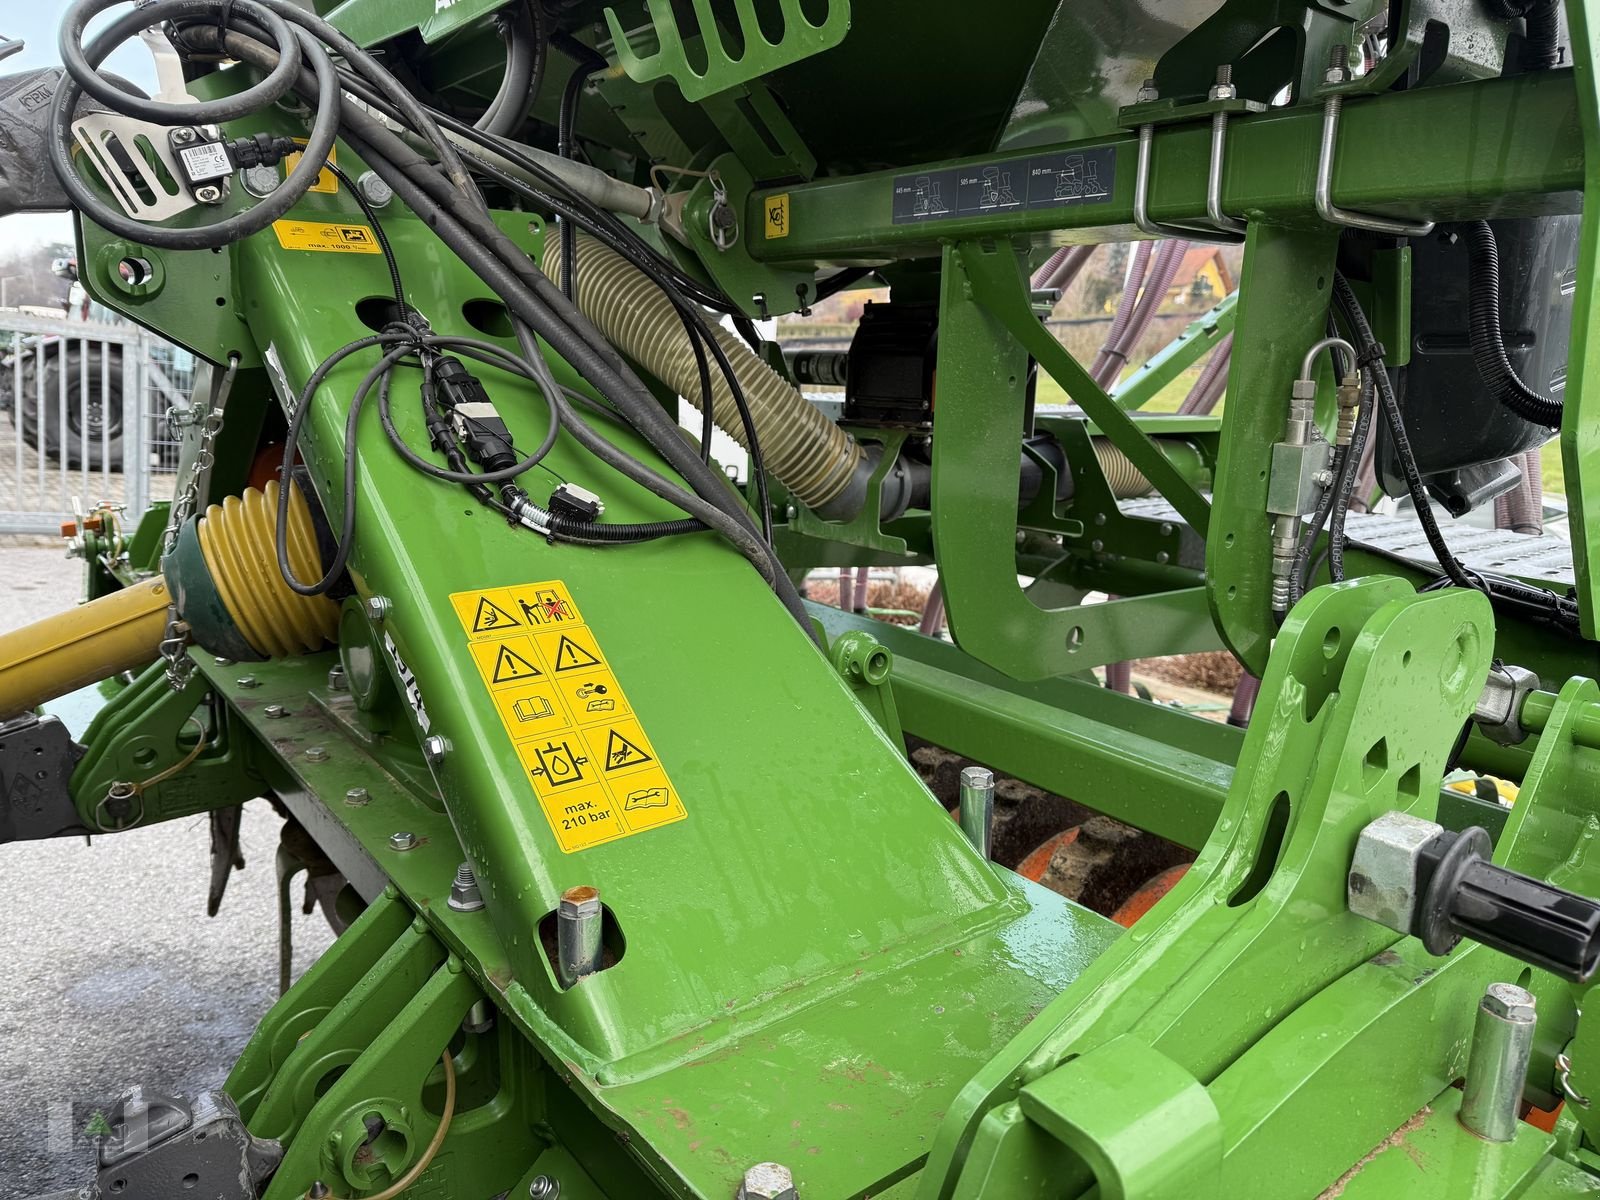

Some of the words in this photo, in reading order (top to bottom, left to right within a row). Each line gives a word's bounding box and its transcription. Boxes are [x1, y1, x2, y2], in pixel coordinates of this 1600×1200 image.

[1352, 435, 1366, 454] BAR
[1341, 458, 1359, 494] 1-2023
[564, 800, 598, 815] max.
[561, 815, 587, 830] 210
[588, 809, 611, 823] bar
